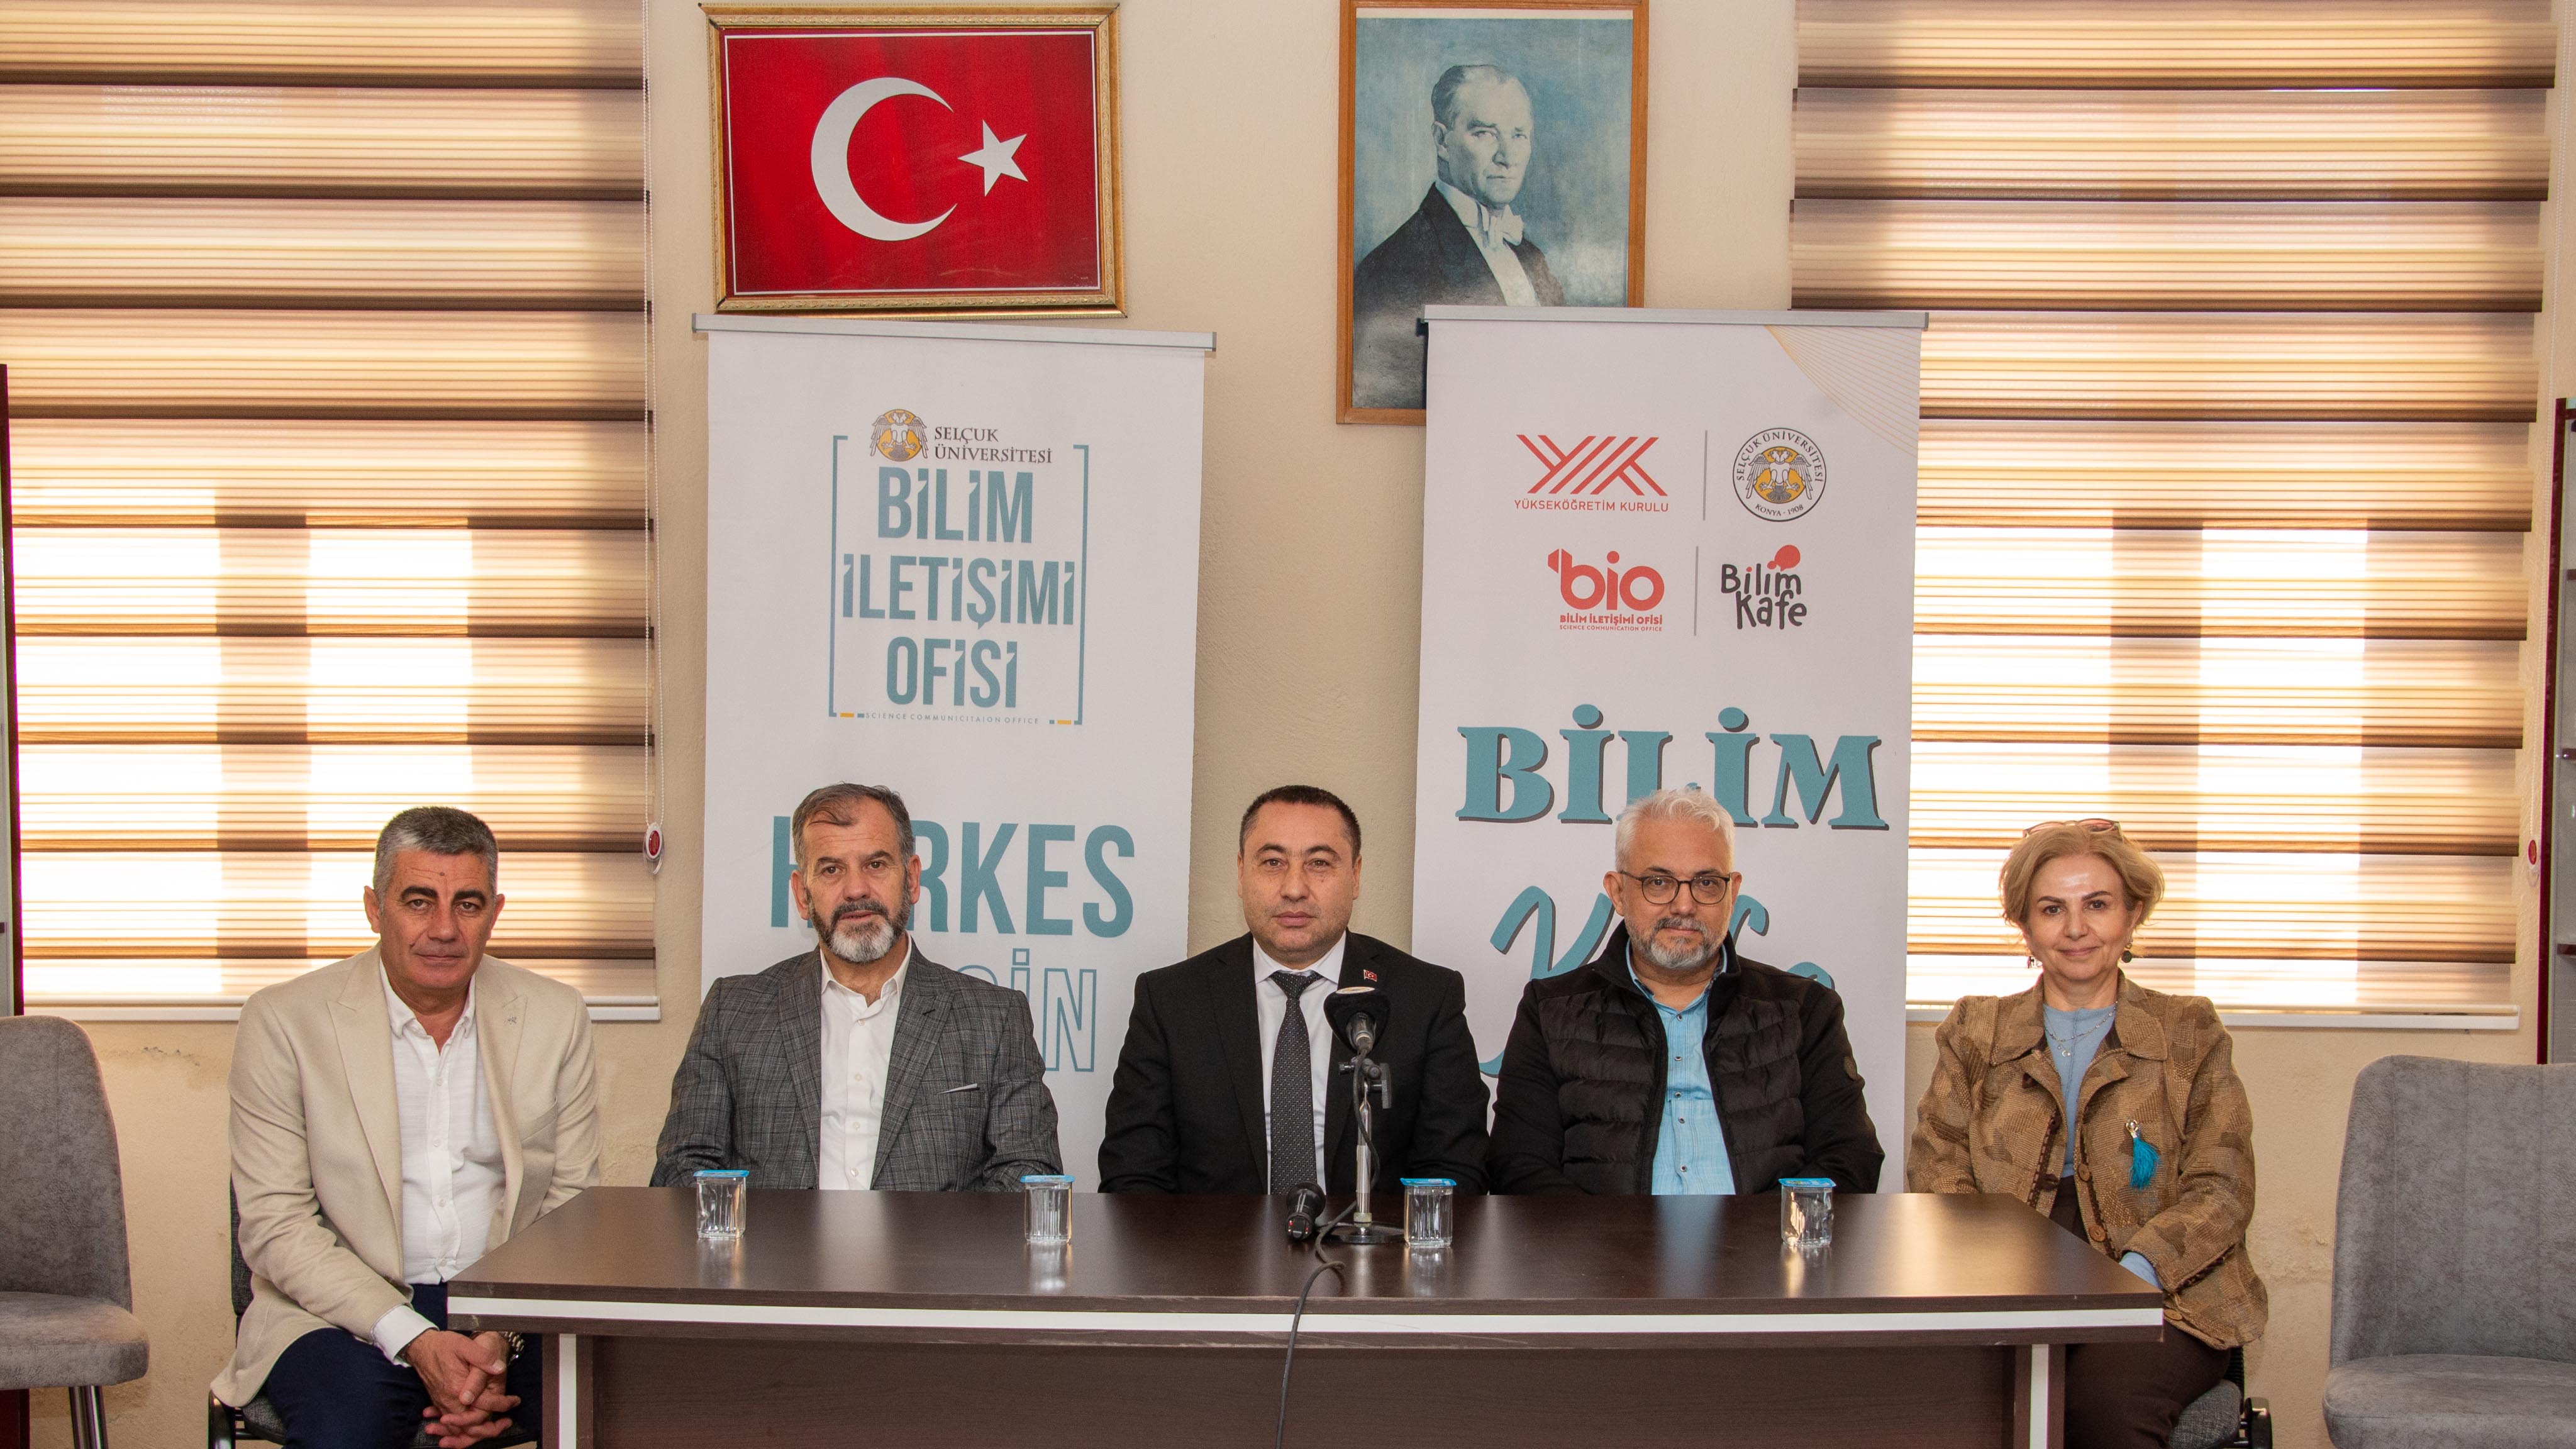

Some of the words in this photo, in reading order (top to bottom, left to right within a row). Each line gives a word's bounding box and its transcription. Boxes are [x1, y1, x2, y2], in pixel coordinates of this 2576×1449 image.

[935, 426, 999, 444] SELÇUK
[935, 443, 1053, 464] ÜNİVERSİTESİ
[1736, 438, 1762, 481] SELÇUK
[1762, 431, 1824, 482] ÜNİVERSİTESİ
[878, 466, 1033, 543] BİLİM
[1514, 498, 1615, 511] YÜKSEKÖĞRETİM
[1620, 502, 1668, 512] KURULU
[1755, 504, 1781, 516] KONYA
[1787, 504, 1804, 515] 1908
[843, 553, 1075, 630] İLETİŞİMİ
[1721, 562, 1801, 597] Bilim
[1560, 613, 1587, 623] BİLİM
[1589, 613, 1634, 626] İLETİŞİMİ
[1636, 614, 1662, 625] OFİSİ
[1736, 590, 1807, 630] Kafe
[886, 636, 1018, 708] OFİSİ
